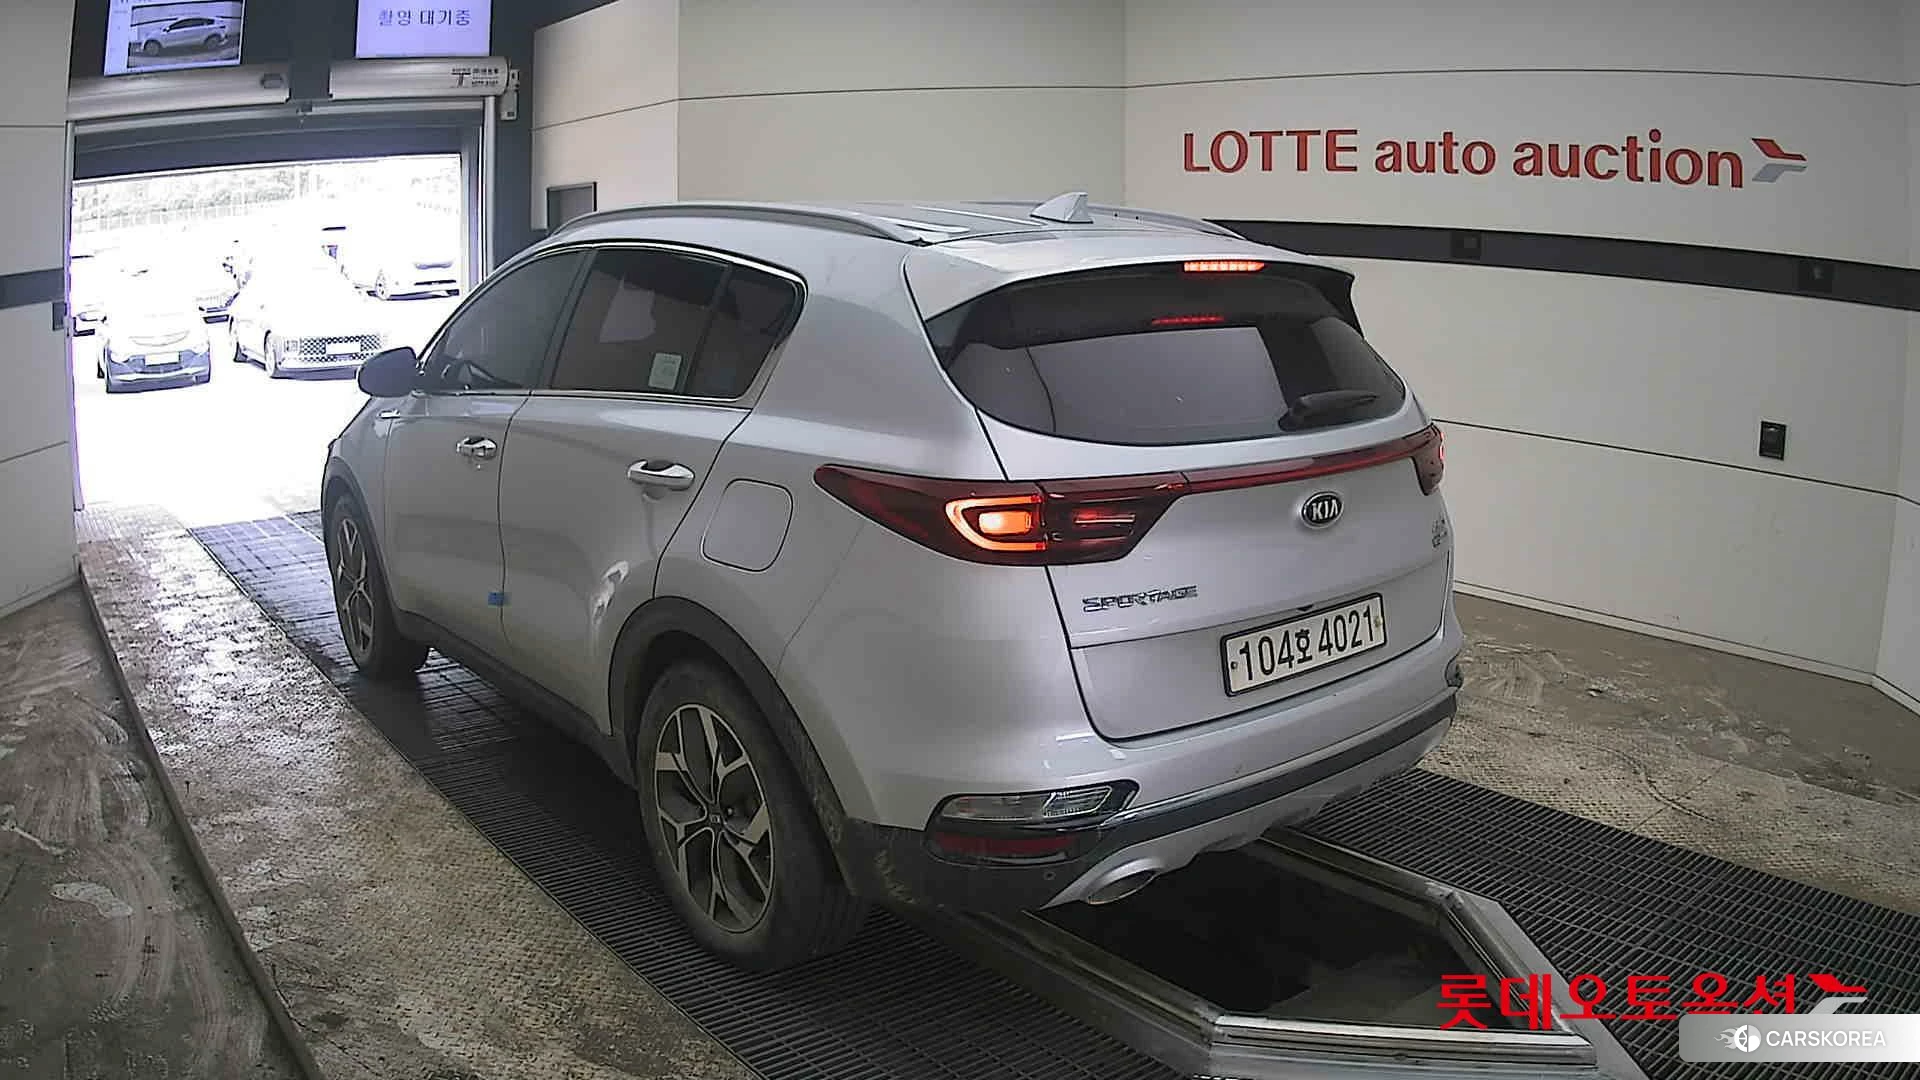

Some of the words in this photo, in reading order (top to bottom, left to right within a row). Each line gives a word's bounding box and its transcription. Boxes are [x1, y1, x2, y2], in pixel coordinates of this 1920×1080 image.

[420, 9, 470, 26] 대기중
[1183, 129, 1358, 173] LOTTE
[1375, 131, 1496, 175] auto
[1512, 128, 1743, 188] auction
[1311, 499, 1338, 521] KIA
[1082, 585, 1198, 612] SPORTAGE
[1318, 604, 1374, 656] 4021
